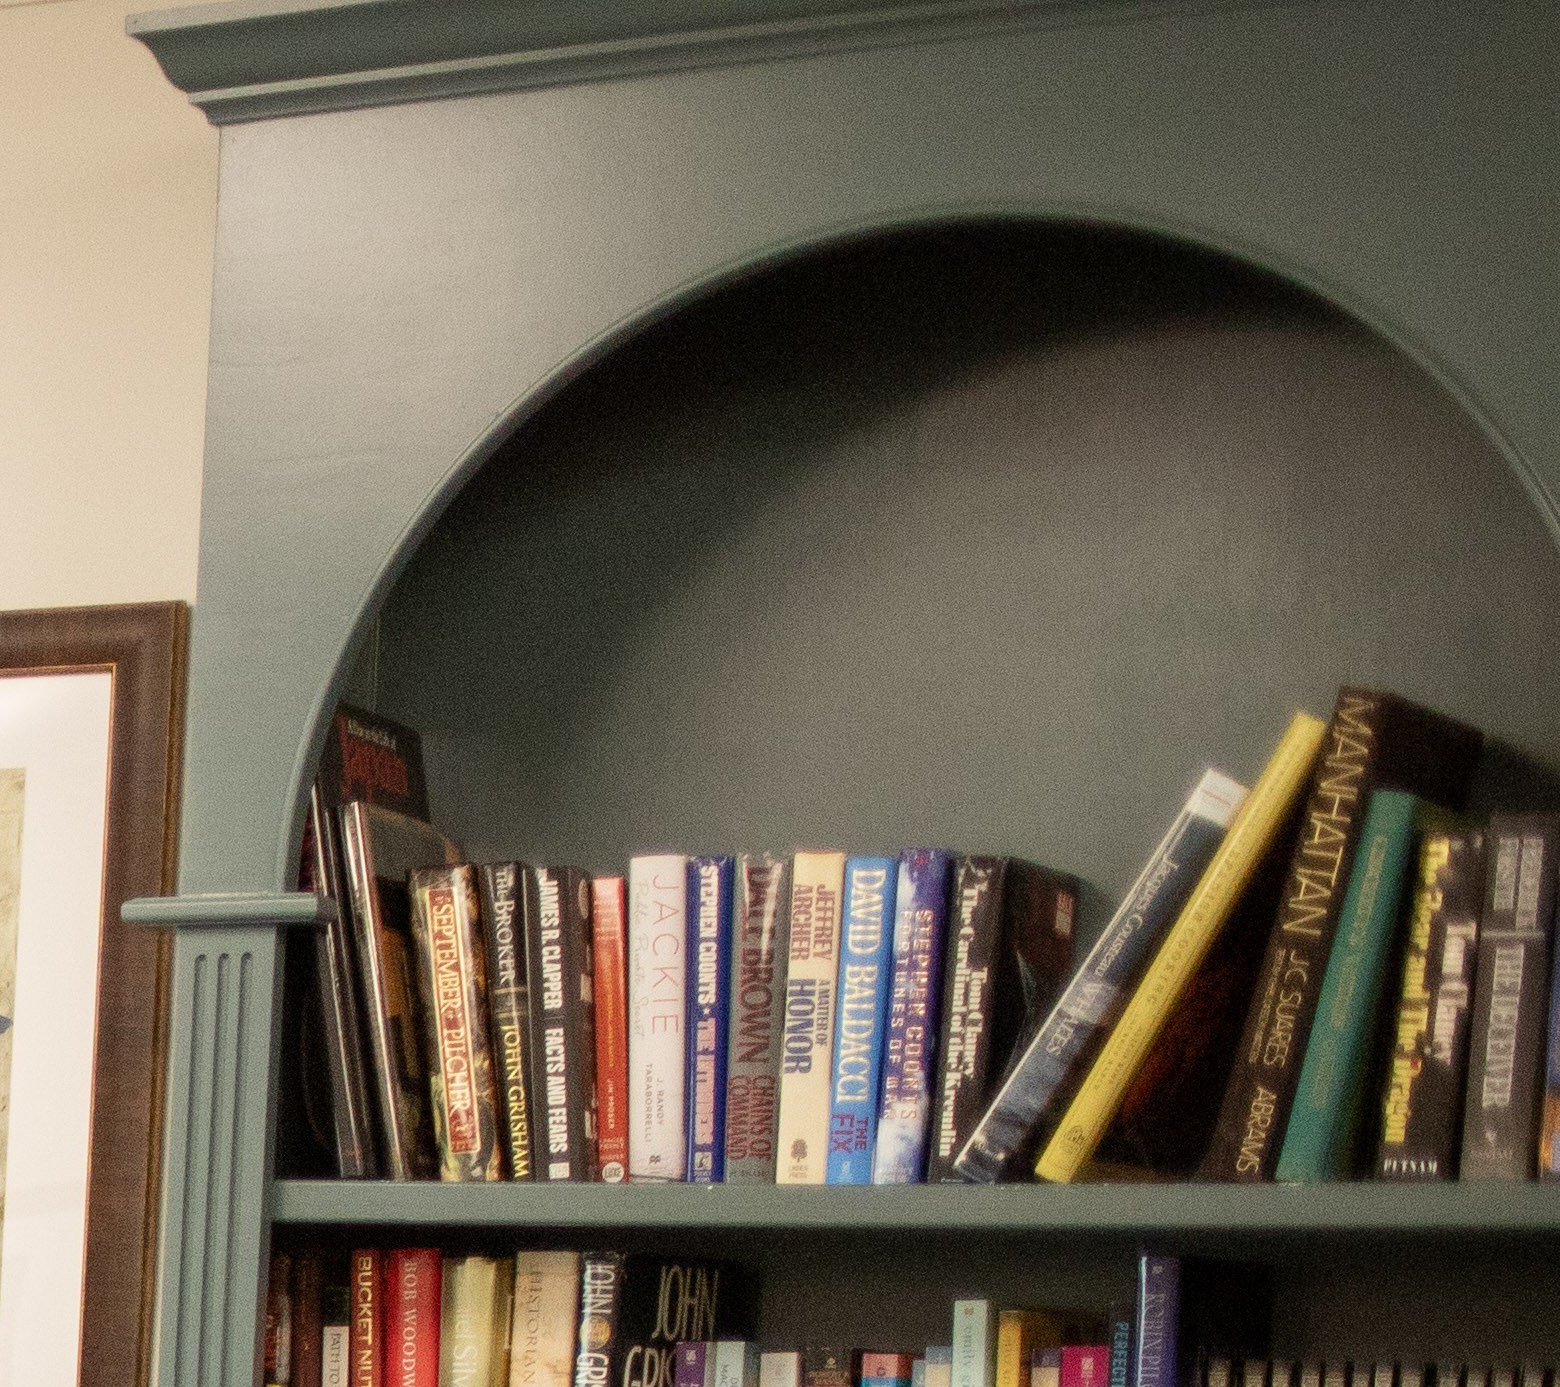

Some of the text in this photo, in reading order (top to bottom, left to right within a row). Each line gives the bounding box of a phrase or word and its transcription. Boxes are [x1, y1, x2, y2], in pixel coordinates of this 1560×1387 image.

[1282, 697, 1374, 937] MANHATTAN
[494, 900, 517, 984] BROKER
[790, 884, 813, 961] ARCHER
[812, 883, 835, 962] JEFFREY
[431, 903, 470, 1116] SEPTEMBER PILCHER
[539, 878, 569, 1153] JAMES R. CLAPPER FACTS AND FEARS
[783, 978, 816, 1075] HONOR
[835, 868, 886, 1105] DAVID BALDACCI
[501, 1023, 522, 1081] JOHN
[506, 1085, 531, 1178] GRISHAM
[830, 1113, 856, 1154] FIX
[853, 1116, 869, 1151] THE
[1235, 1085, 1277, 1174] ABRAMS
[357, 1256, 373, 1345] BUCKET
[403, 1259, 418, 1301] BOB
